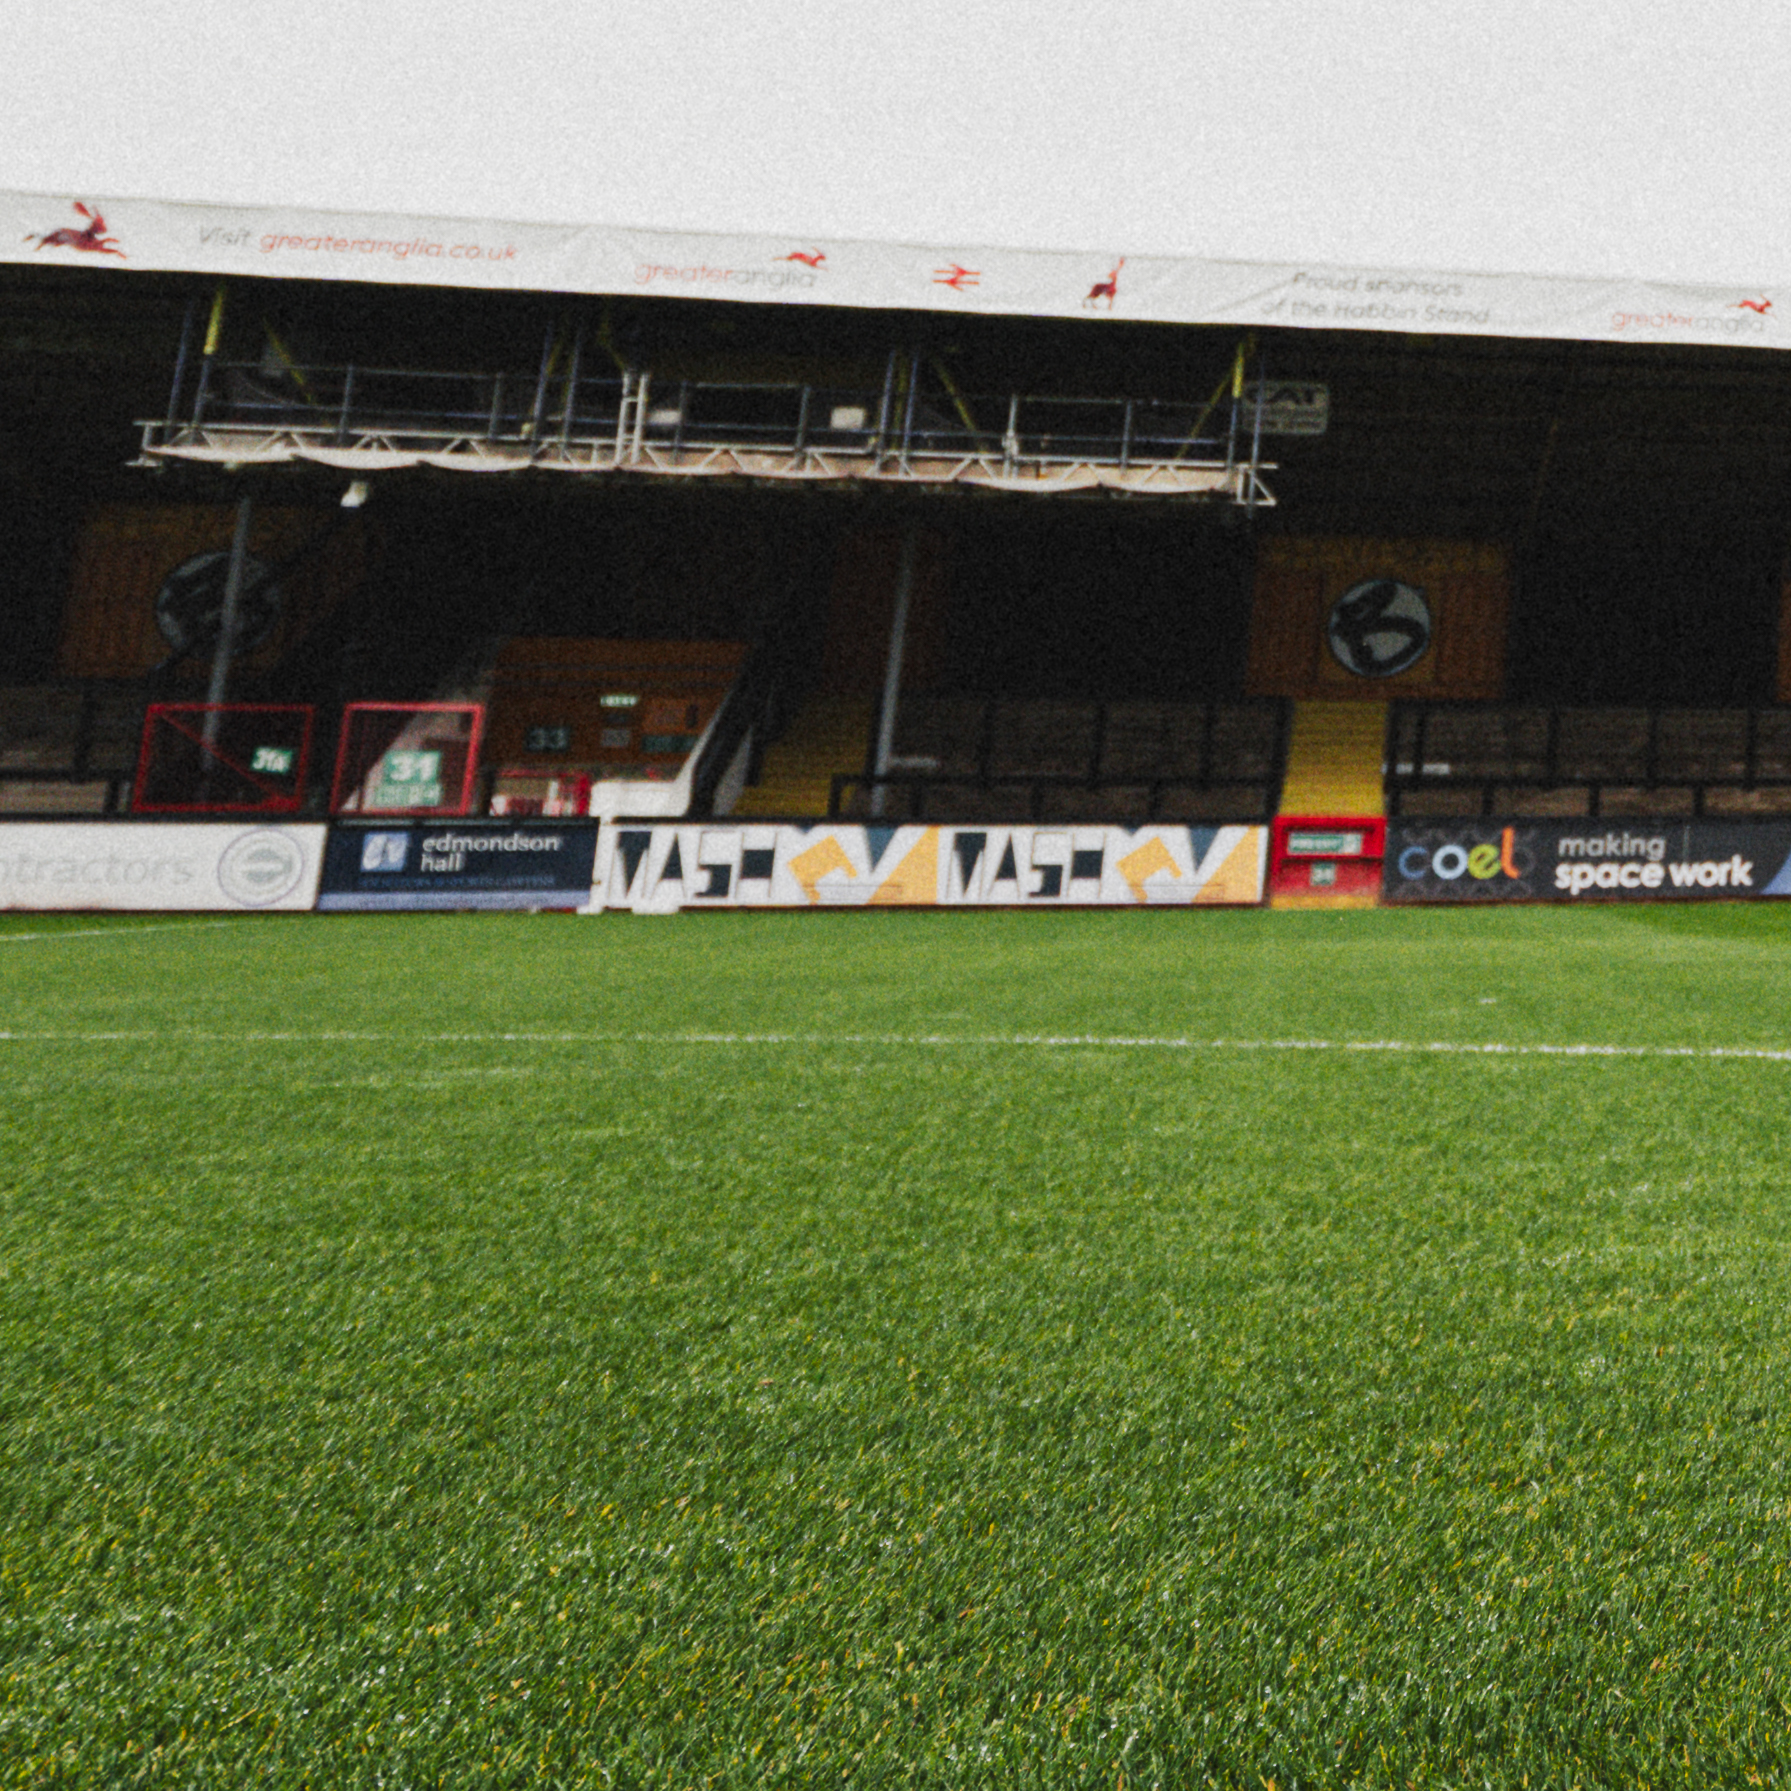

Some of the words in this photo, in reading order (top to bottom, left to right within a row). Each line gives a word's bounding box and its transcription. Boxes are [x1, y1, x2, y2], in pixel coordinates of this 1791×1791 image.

[201, 228, 249, 247] Visit
[260, 231, 518, 263] greateranglia.co.uk
[634, 261, 818, 289] greateranglia
[1422, 303, 1491, 325] Stand
[1611, 309, 1765, 334] greateranglia
[389, 753, 439, 782] 31
[421, 832, 562, 852] edmondson
[1557, 834, 1667, 862] making
[421, 852, 464, 872] hall
[1554, 861, 1665, 896] space
[1669, 855, 1754, 888] work
